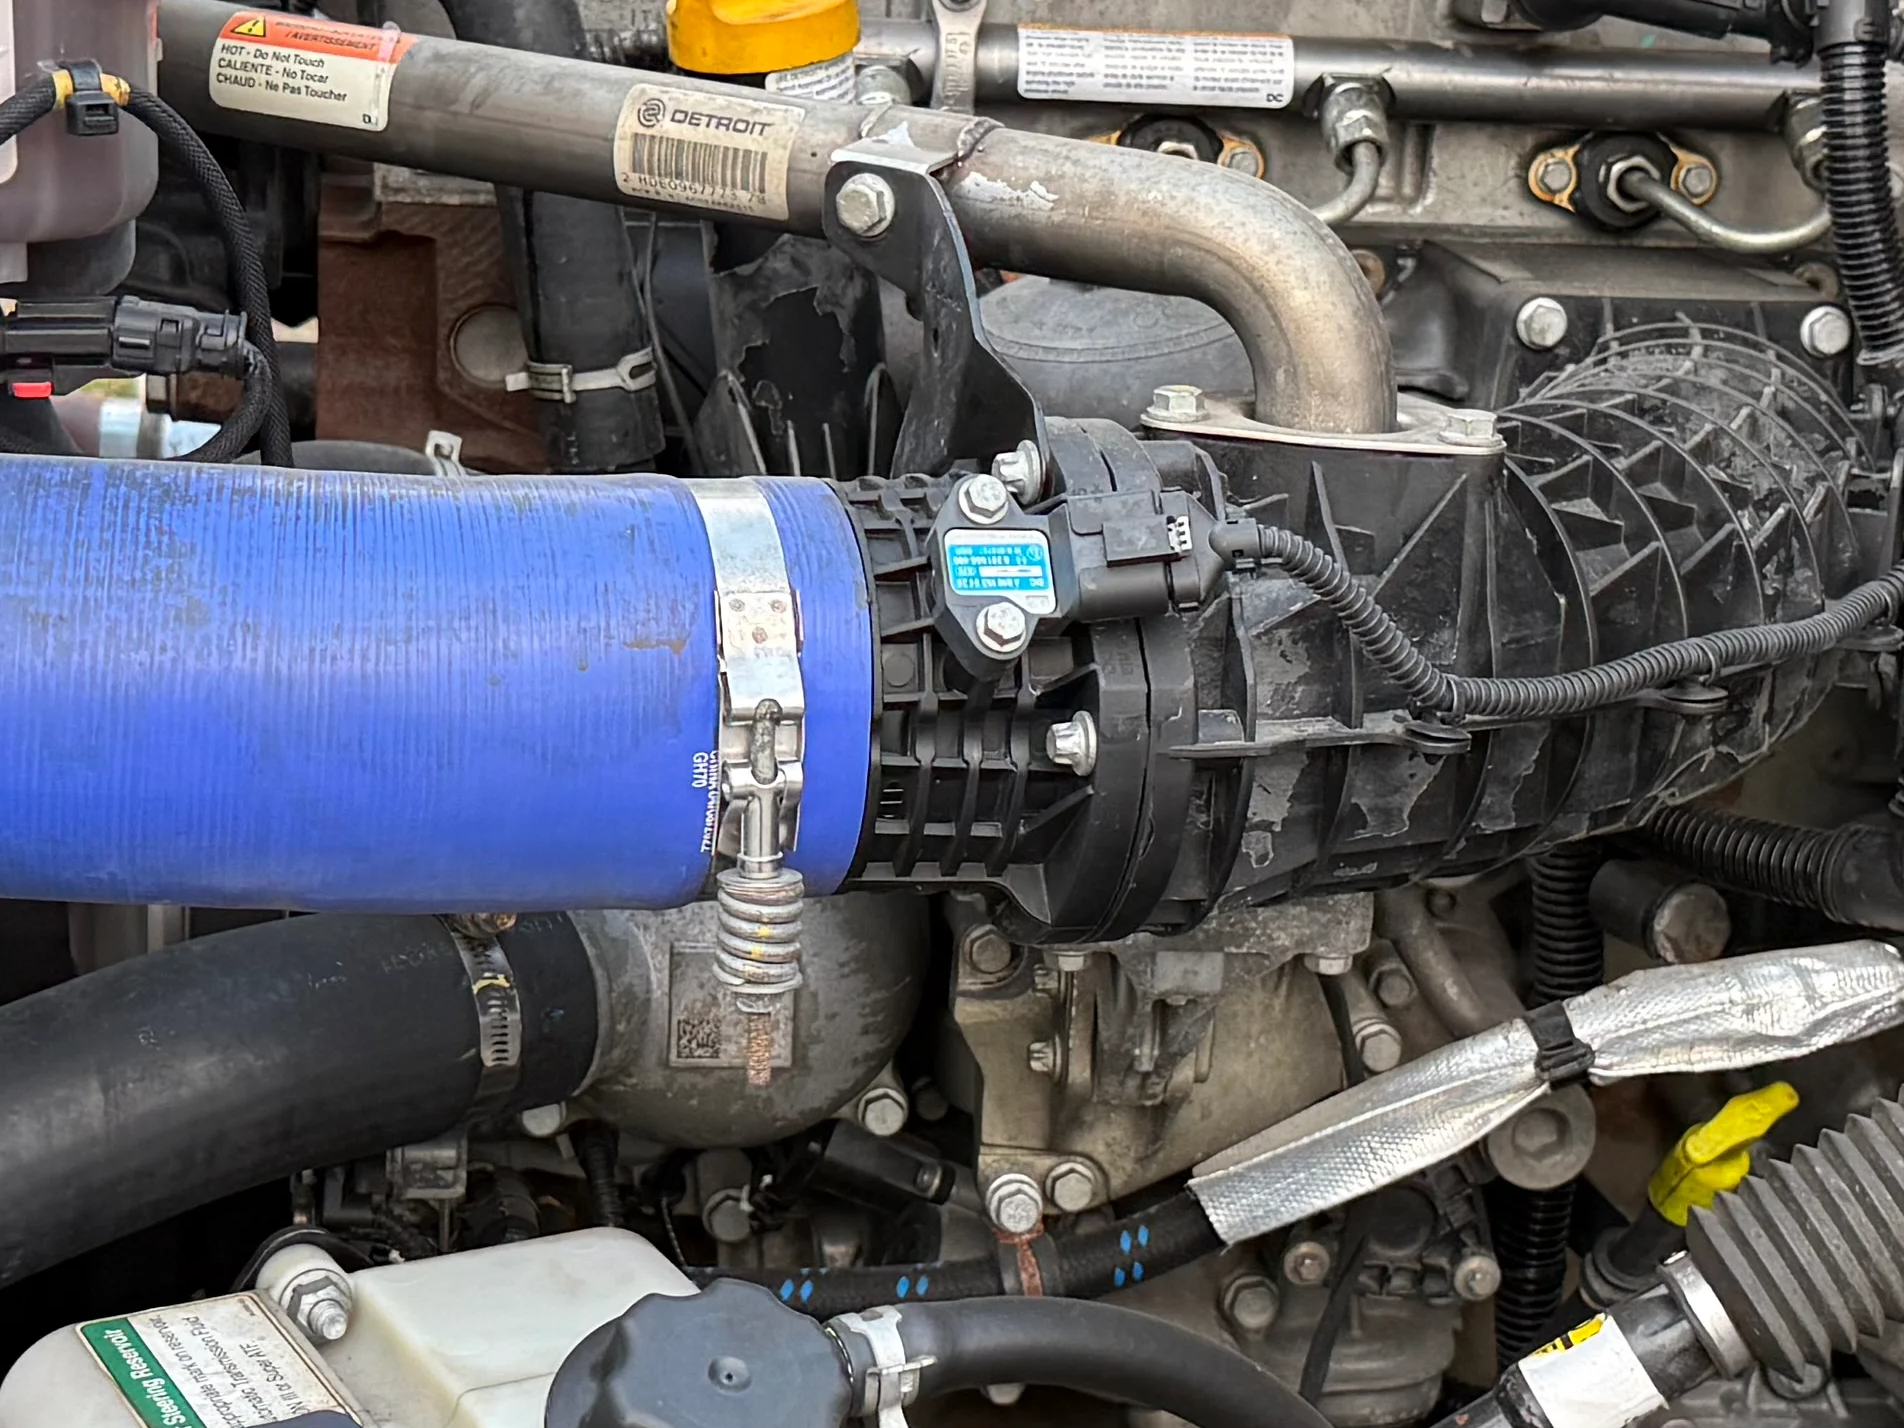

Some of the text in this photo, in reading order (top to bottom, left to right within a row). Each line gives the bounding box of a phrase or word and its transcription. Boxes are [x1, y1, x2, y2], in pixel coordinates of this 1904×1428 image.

[220, 43, 325, 69] HOT Do Not Touch
[217, 57, 329, 84] CALIENTE No Tocar
[216, 72, 348, 102] CHAUD Ne Pas Toucher
[1265, 92, 1285, 103] DC
[669, 108, 777, 137] DETROIT
[691, 751, 710, 788] GH70
[102, 1326, 153, 1379] Reservoir
[176, 1350, 191, 1362] on
[182, 1314, 248, 1387] Transmission Fluid
[180, 1361, 207, 1384] mark
[254, 1356, 285, 1382] Super
[275, 1380, 291, 1392] or
[139, 1377, 187, 1426] Steering
